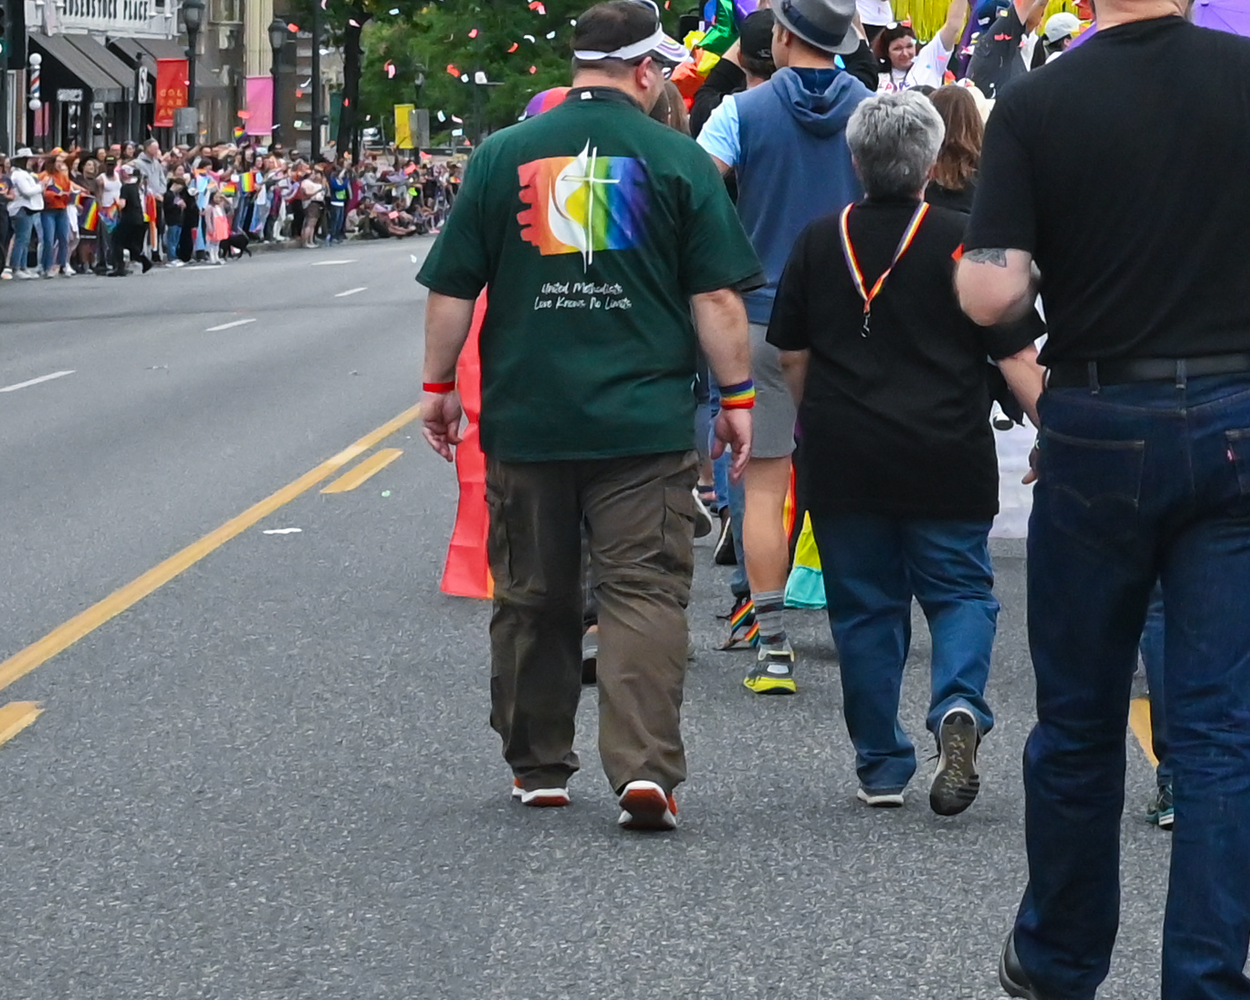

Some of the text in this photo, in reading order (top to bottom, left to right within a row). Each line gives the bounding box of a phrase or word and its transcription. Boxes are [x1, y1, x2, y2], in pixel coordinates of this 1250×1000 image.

[123, 0, 148, 21] PLACE
[541, 282, 623, 295] United Methodists
[534, 296, 632, 310] Love Knows No Limits
